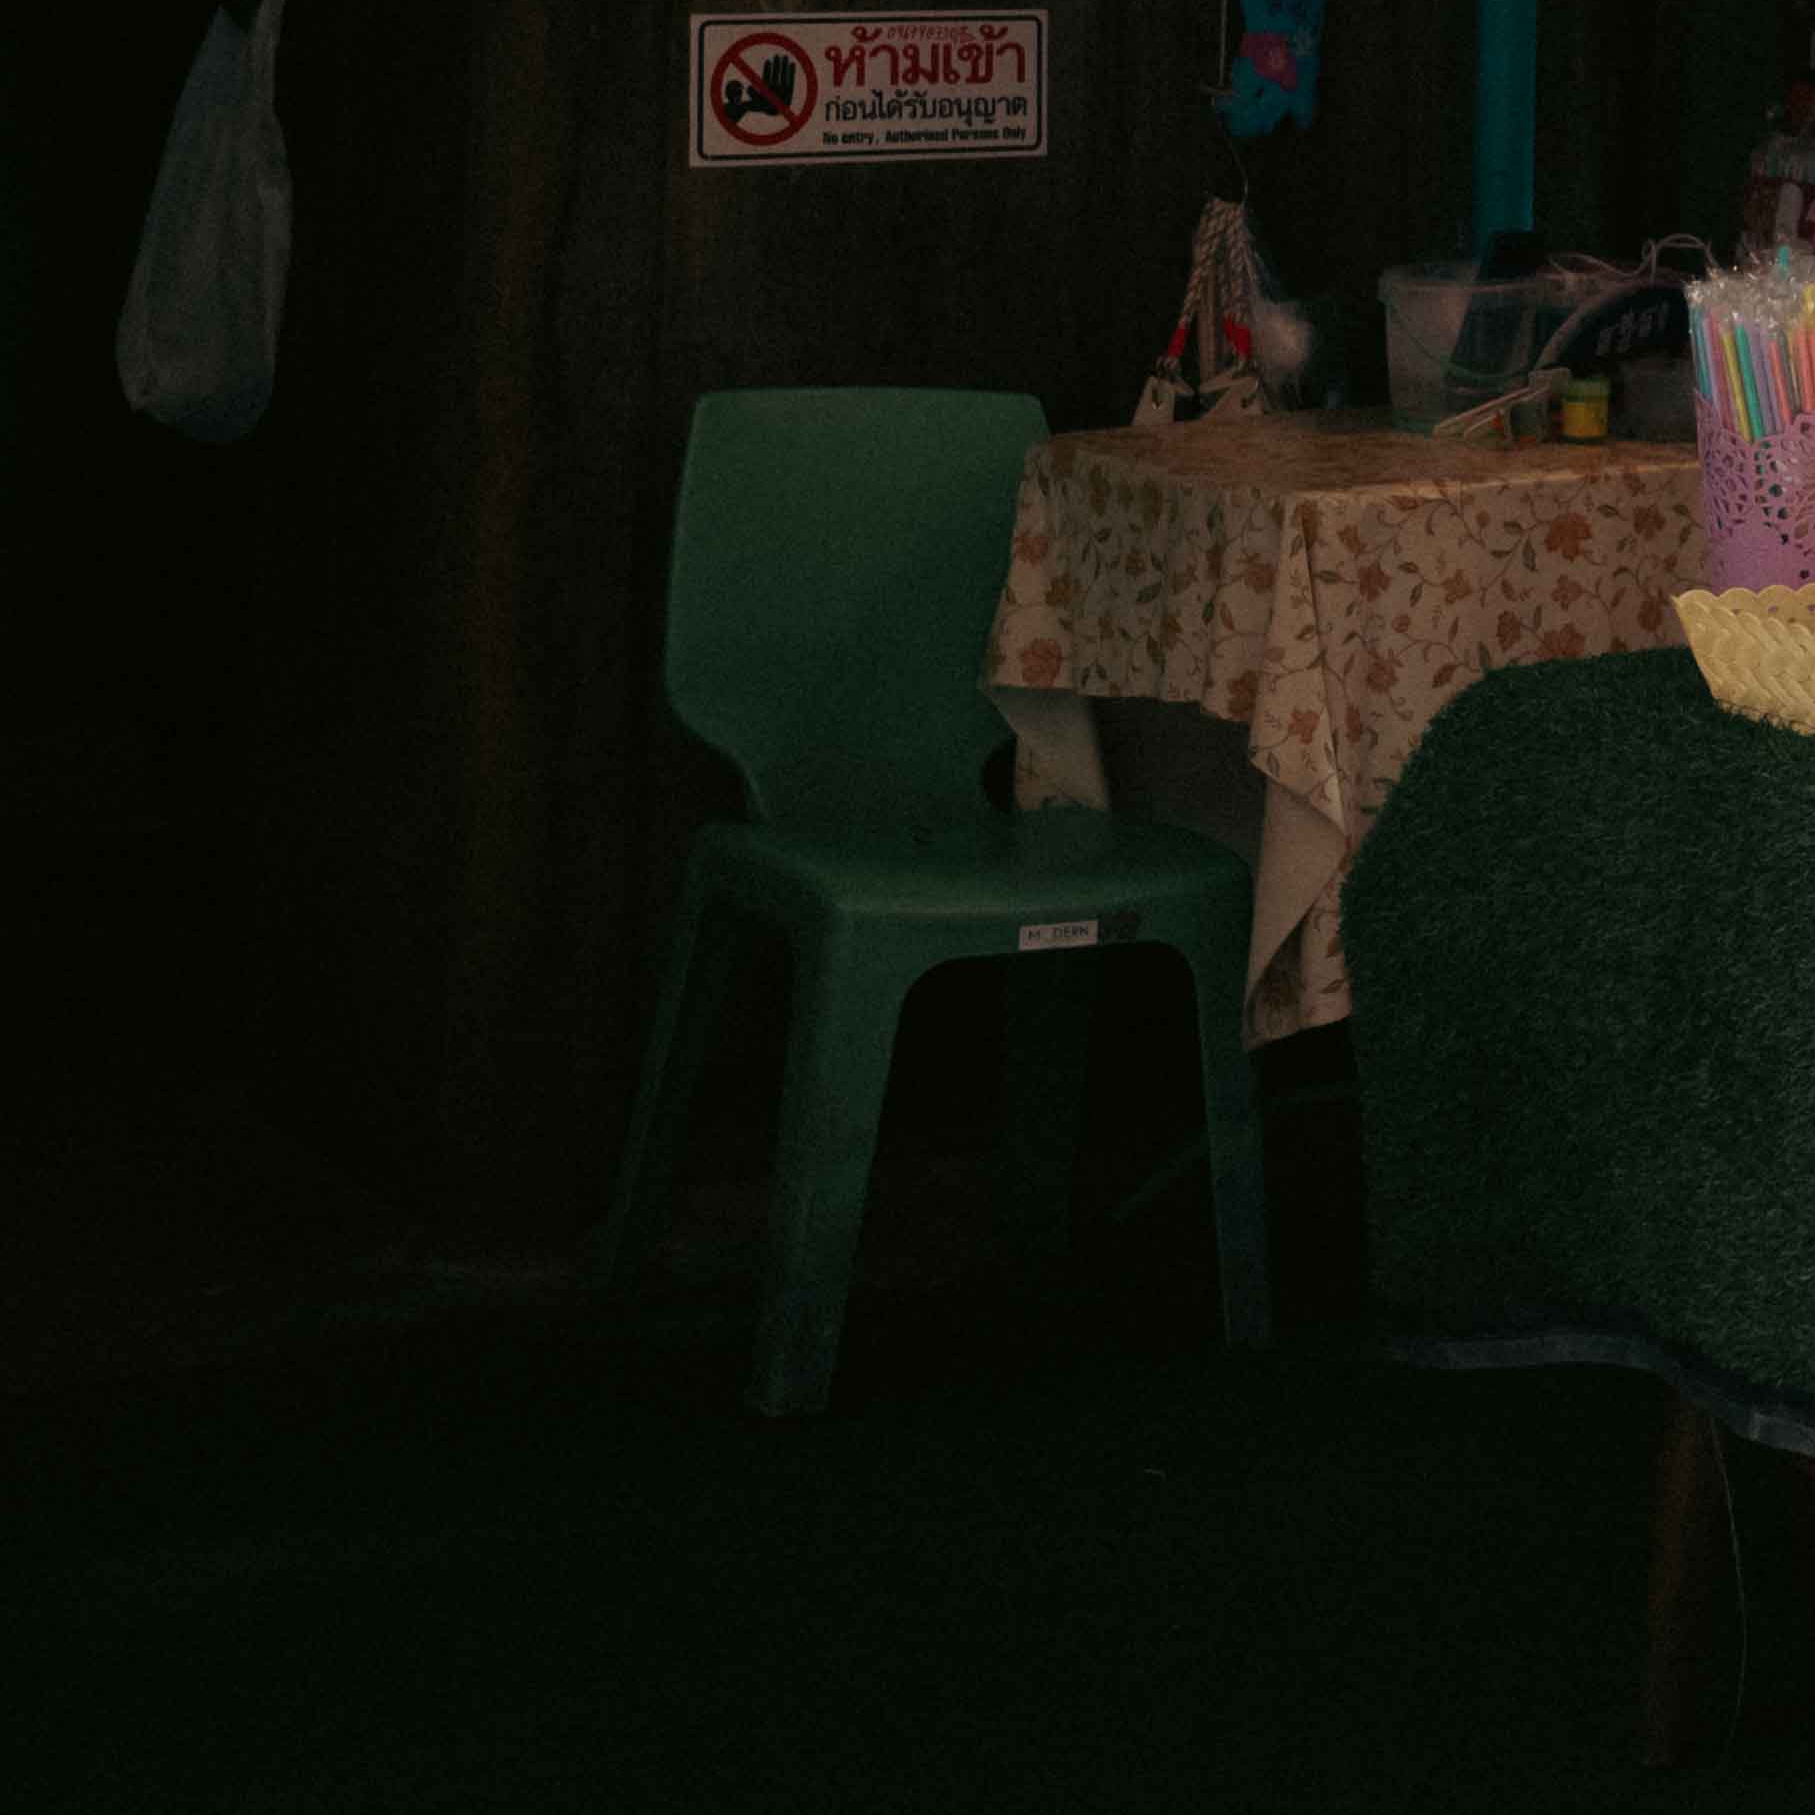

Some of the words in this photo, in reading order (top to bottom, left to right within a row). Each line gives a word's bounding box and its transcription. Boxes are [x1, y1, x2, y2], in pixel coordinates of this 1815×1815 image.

[825, 25, 1026, 87] ห้ามเข้า
[824, 88, 1028, 126] ก่อนได้รับอนุญาต
